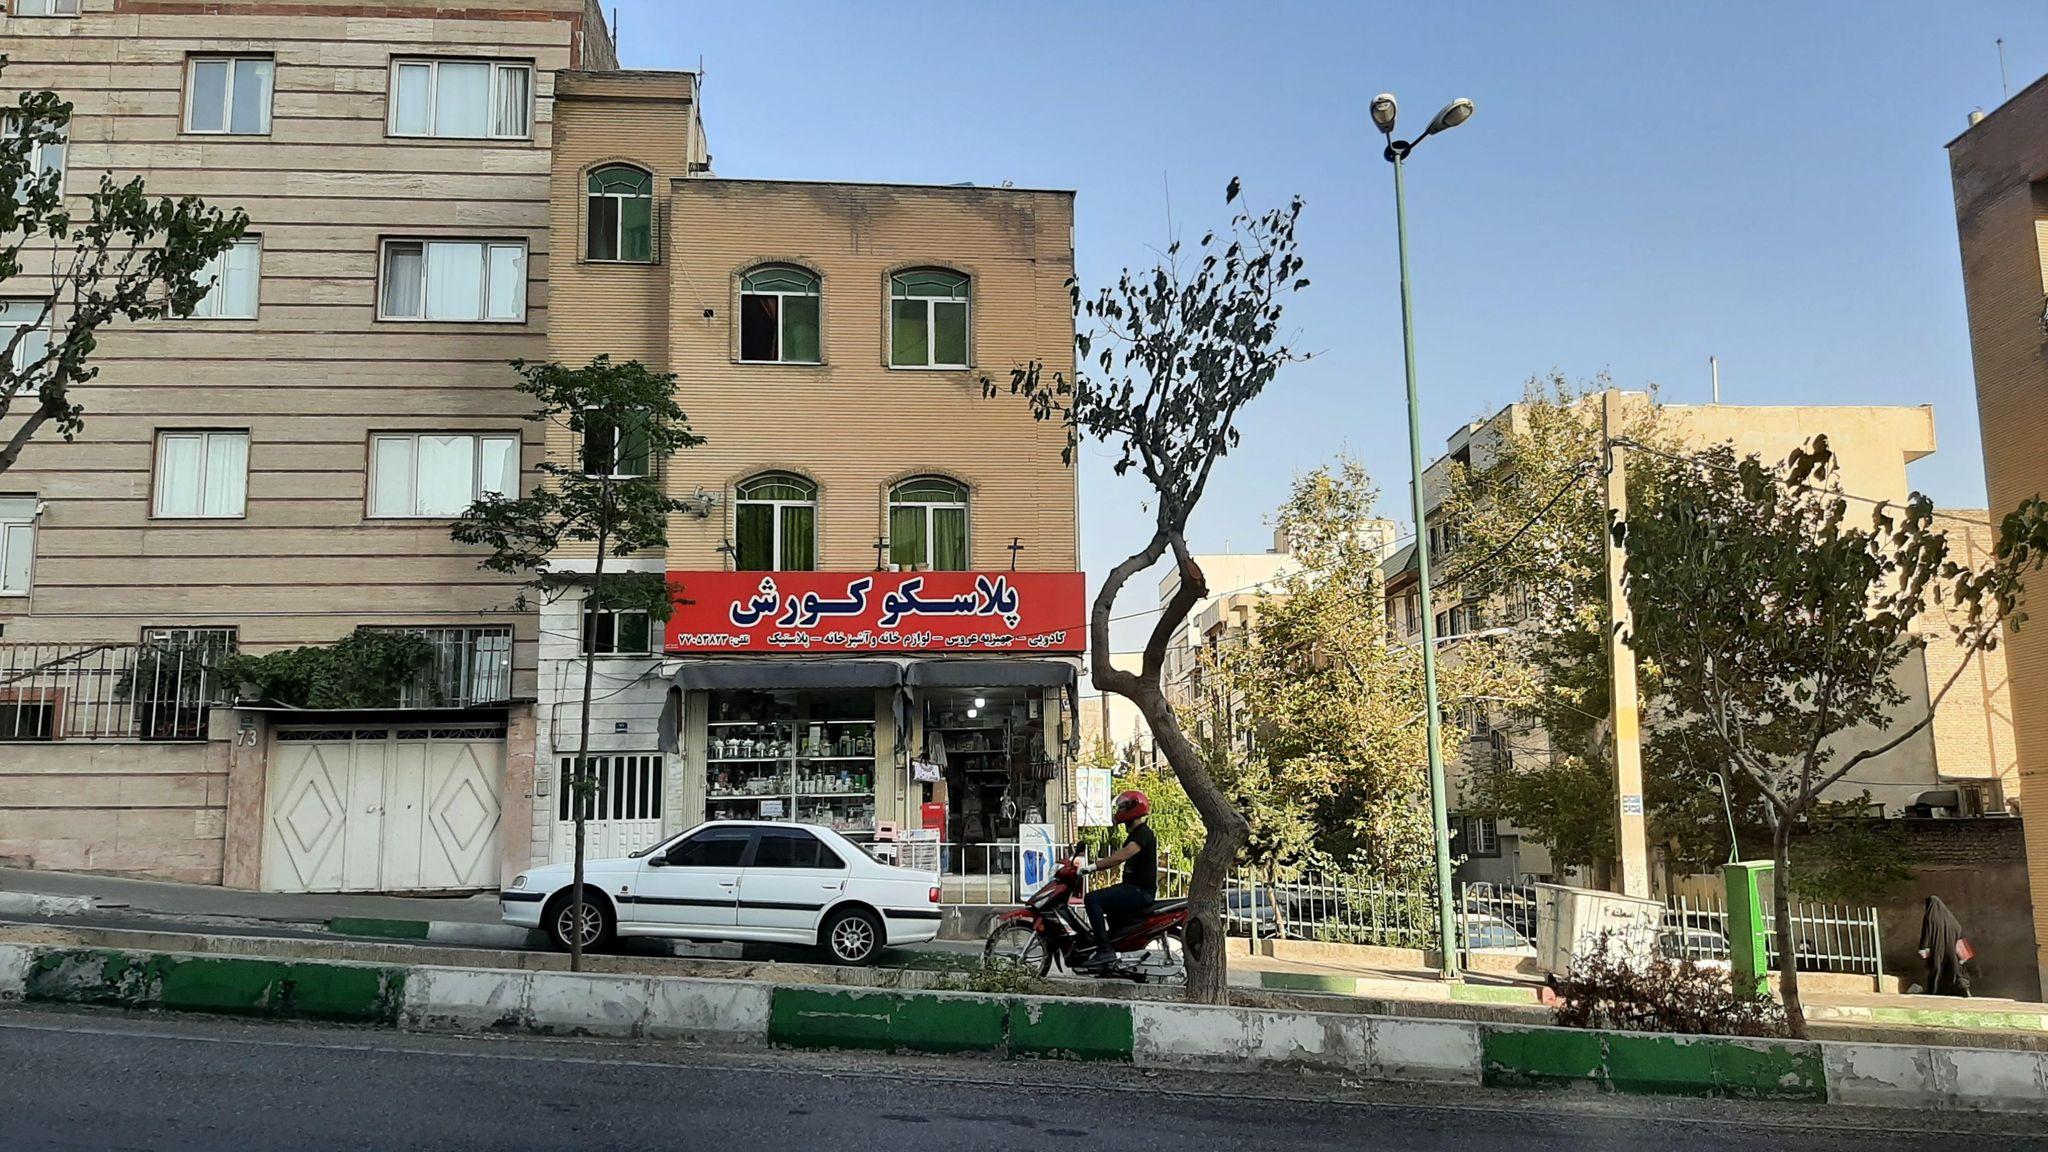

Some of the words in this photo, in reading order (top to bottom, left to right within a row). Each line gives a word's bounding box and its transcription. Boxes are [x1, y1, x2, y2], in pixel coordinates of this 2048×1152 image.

[730, 577, 873, 628] کورش
[878, 575, 1021, 627] پلاسکو
[766, 631, 810, 648] پلاستیک
[878, 631, 901, 645] خانه
[902, 631, 931, 647] لوازم
[945, 632, 978, 648] عروس
[979, 633, 1014, 647] جهیزیه
[1028, 631, 1066, 648] کادویی
[236, 729, 257, 747] 73
